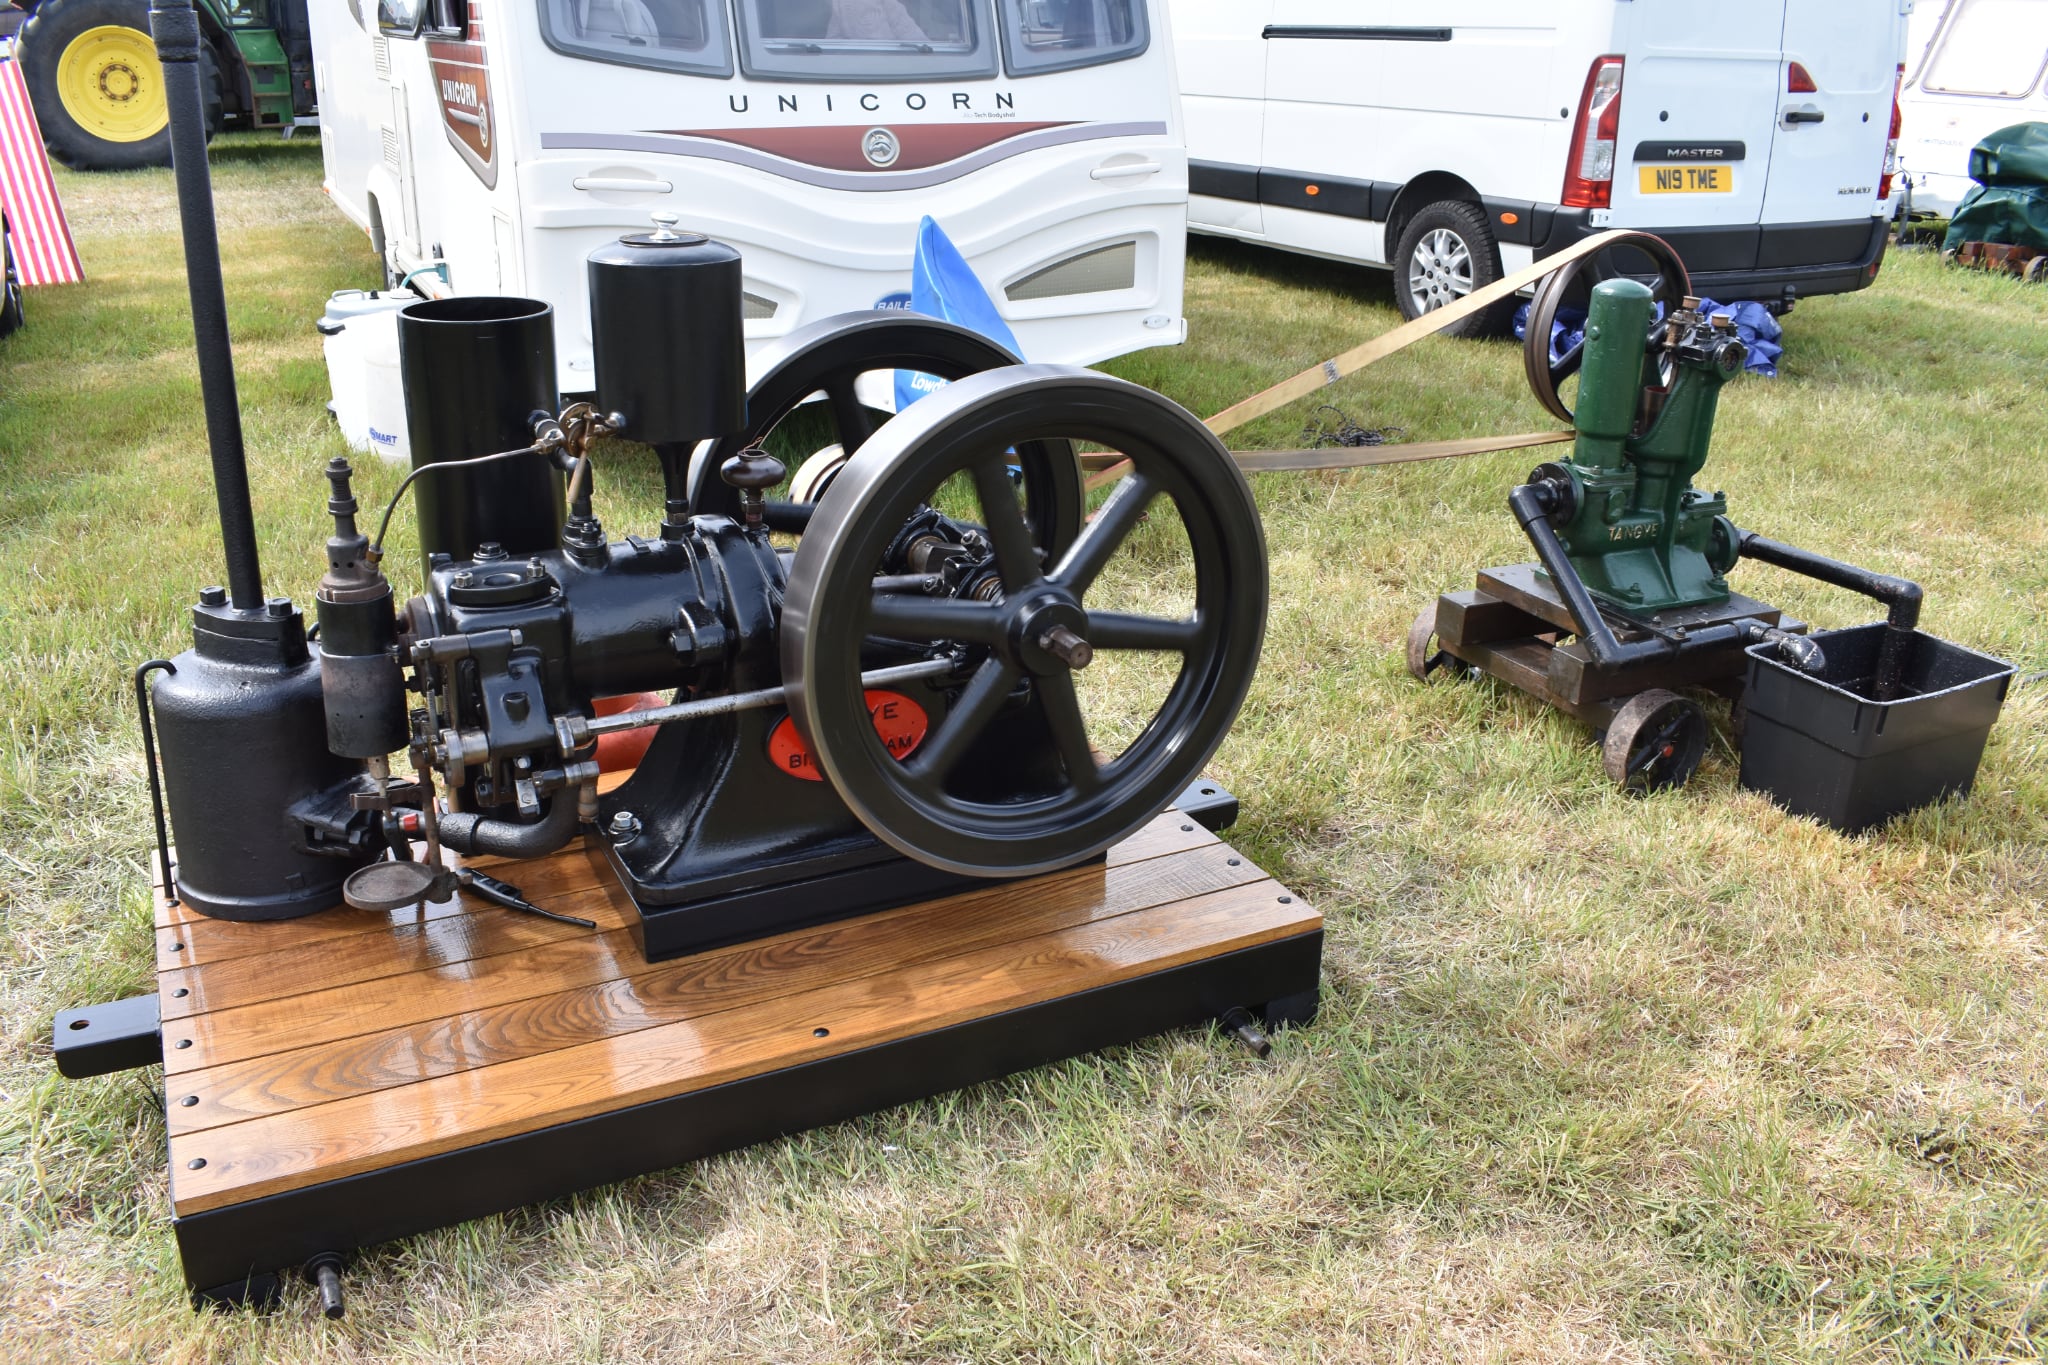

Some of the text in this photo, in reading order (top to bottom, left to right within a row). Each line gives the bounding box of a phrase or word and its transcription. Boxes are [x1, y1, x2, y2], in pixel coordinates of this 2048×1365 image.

[442, 80, 477, 107] UNICORN
[729, 92, 1014, 113] UNICORN
[1667, 148, 1724, 158] MASTER
[1687, 169, 1718, 189] TME
[1608, 523, 1658, 541] TANGYE
